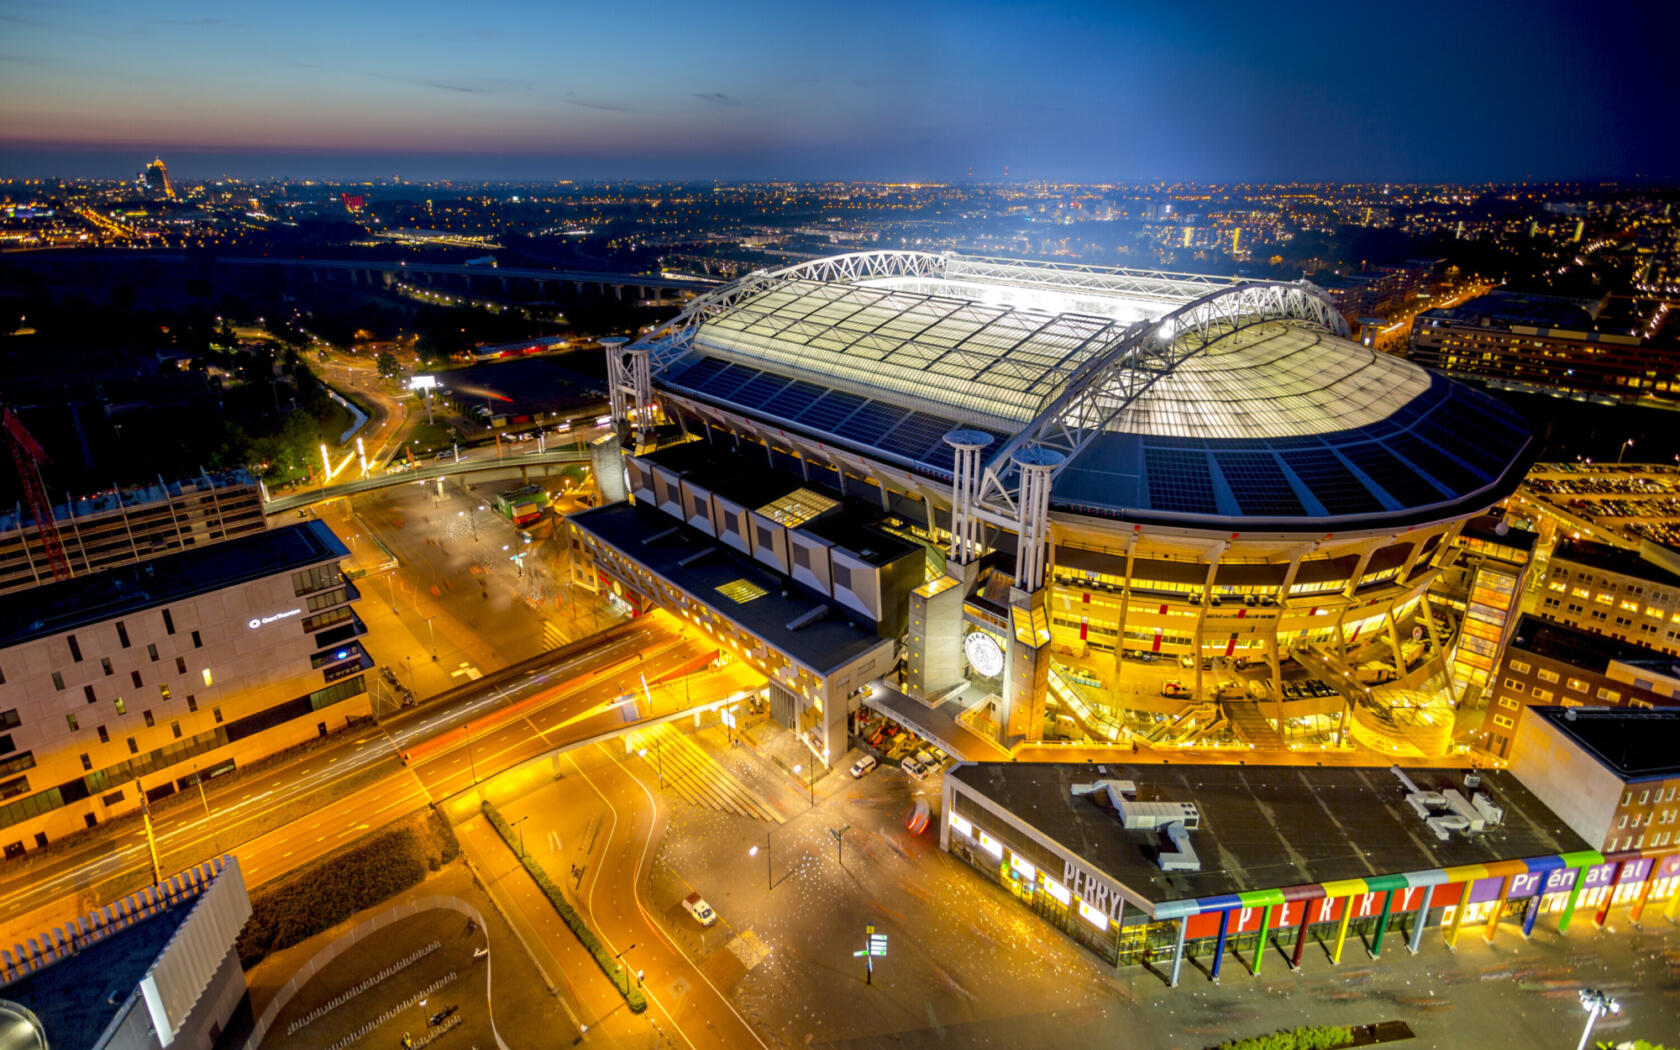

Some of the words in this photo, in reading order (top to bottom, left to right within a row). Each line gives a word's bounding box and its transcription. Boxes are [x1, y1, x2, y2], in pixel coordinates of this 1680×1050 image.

[1064, 861, 1121, 921] PERRY
[1511, 862, 1643, 893] Prénatal
[1238, 887, 1415, 932] PERRY
